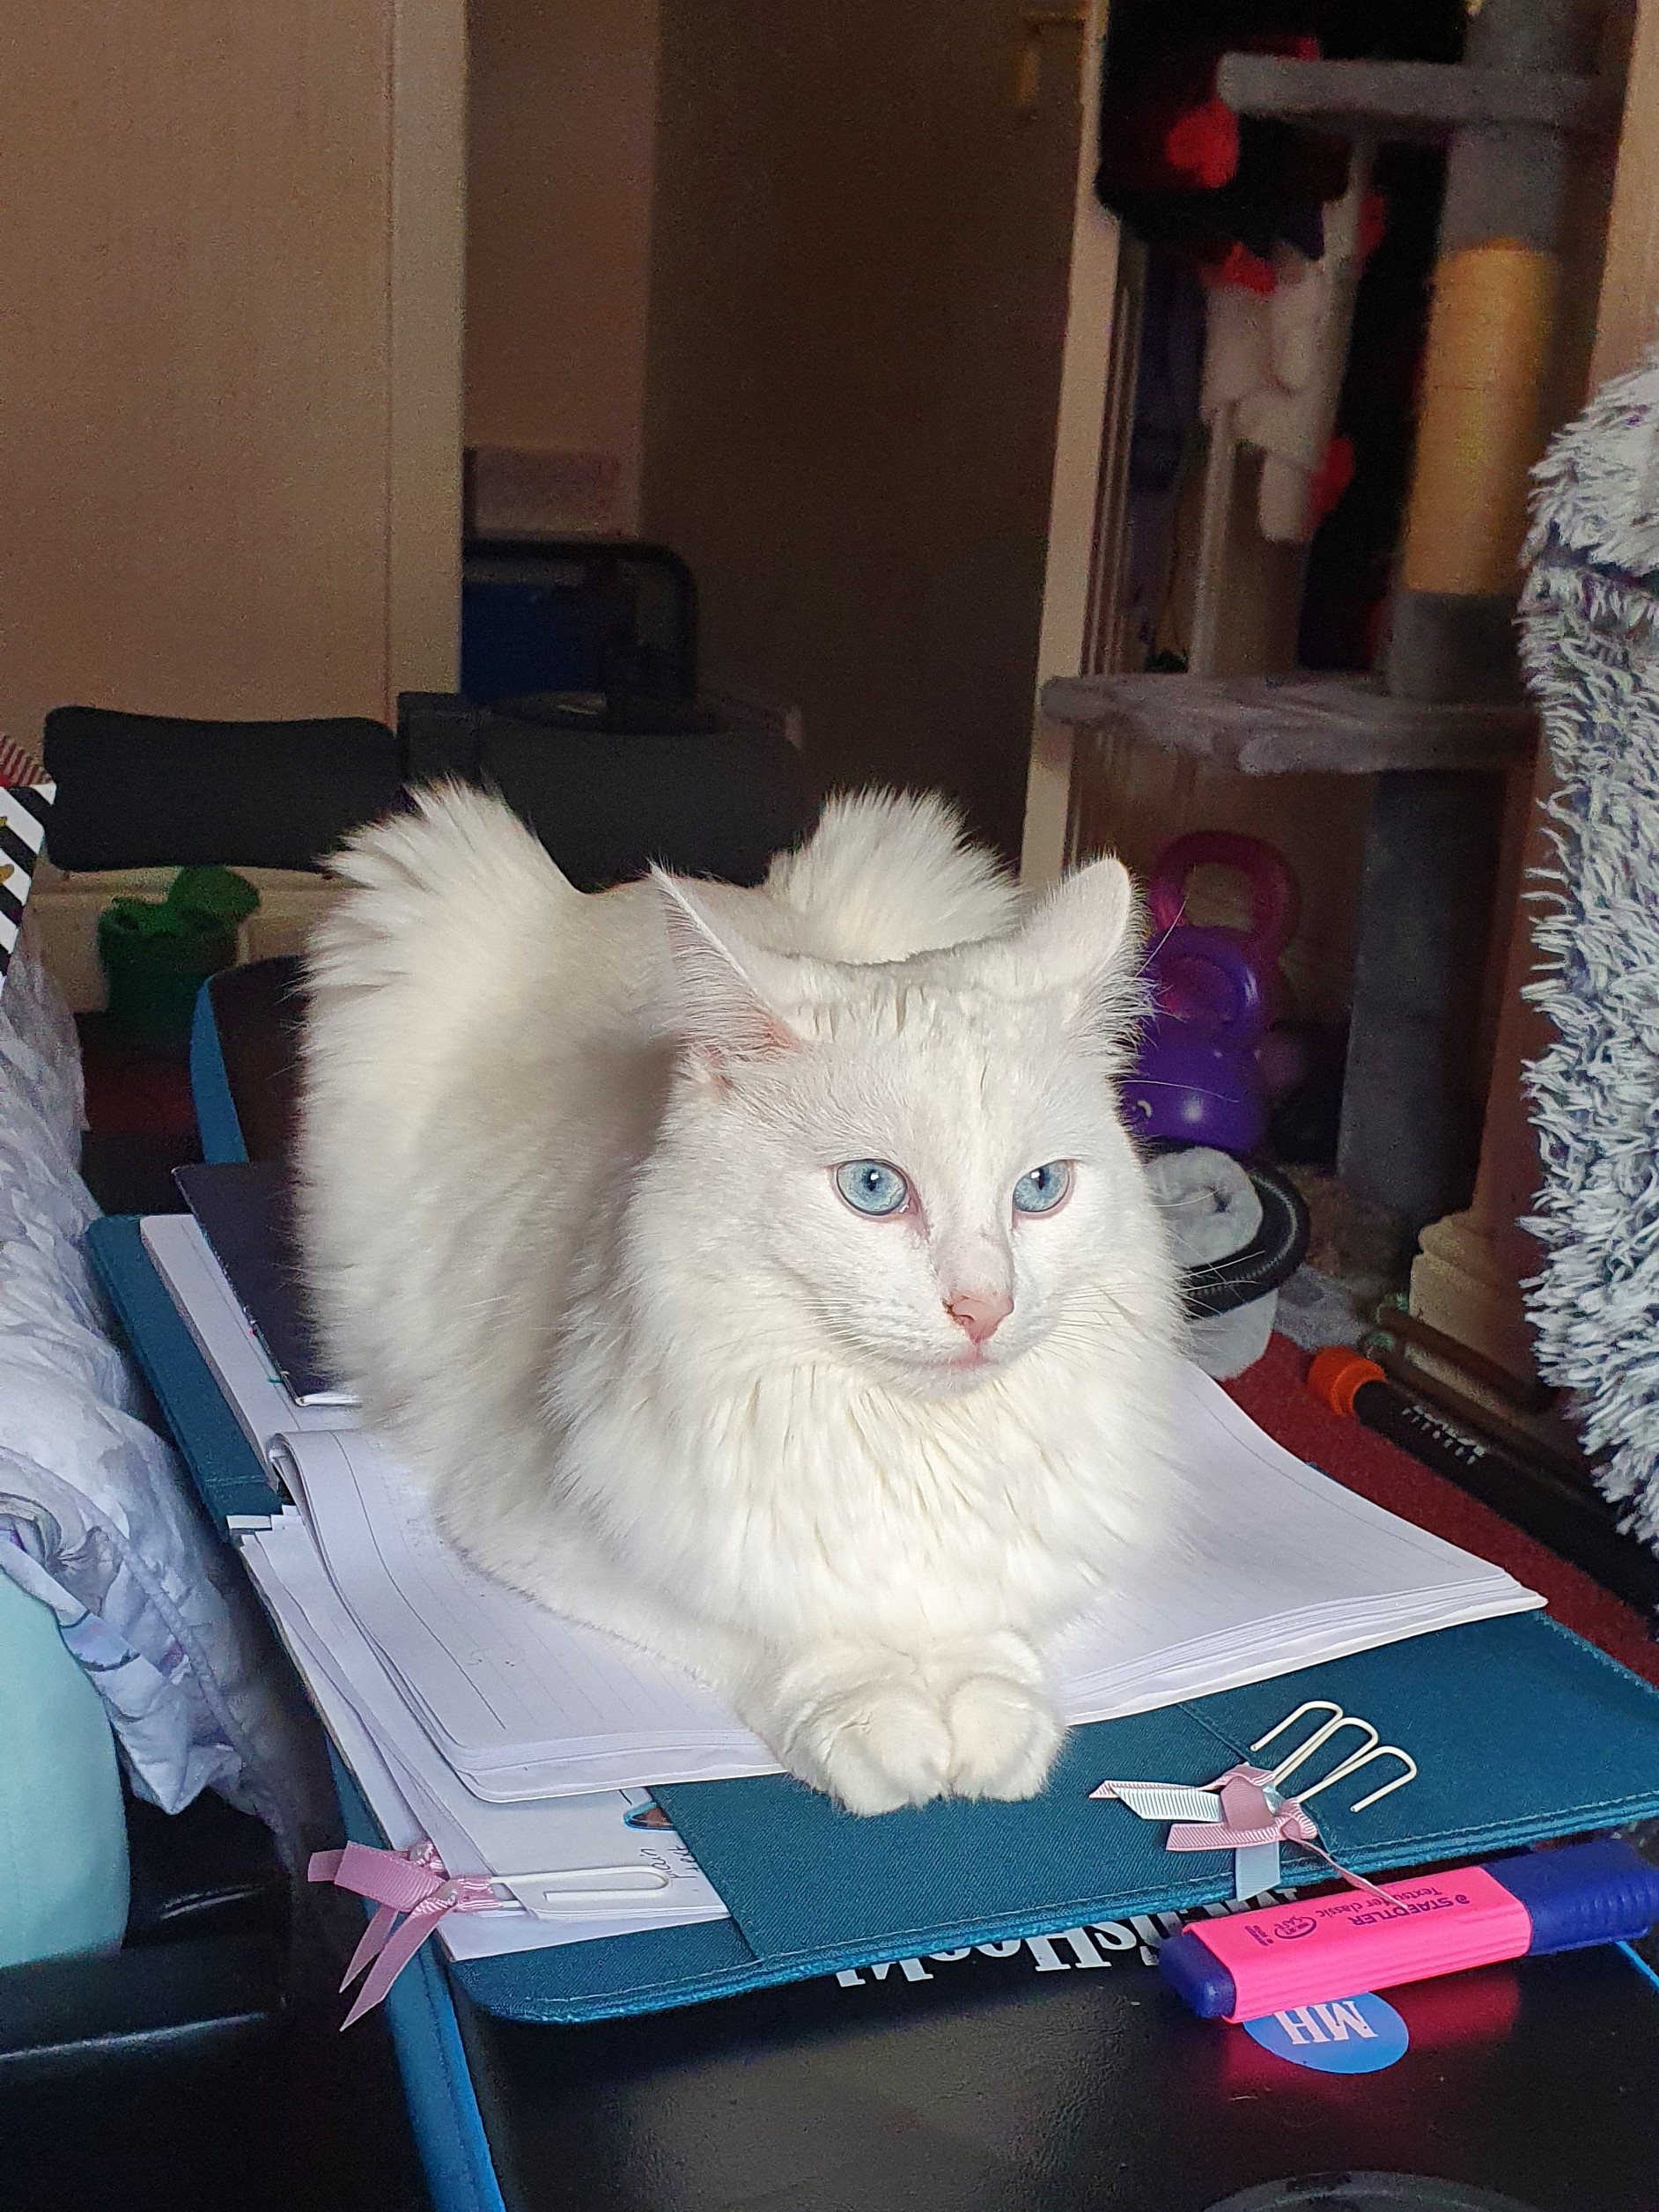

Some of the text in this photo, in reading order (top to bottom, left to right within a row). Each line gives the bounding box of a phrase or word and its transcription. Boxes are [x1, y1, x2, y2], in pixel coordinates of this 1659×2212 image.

[1315, 1886, 1443, 1918] Textsufer classic
[1347, 1897, 1455, 1926] STAEDTLER
[1273, 2000, 1379, 2046] MH
